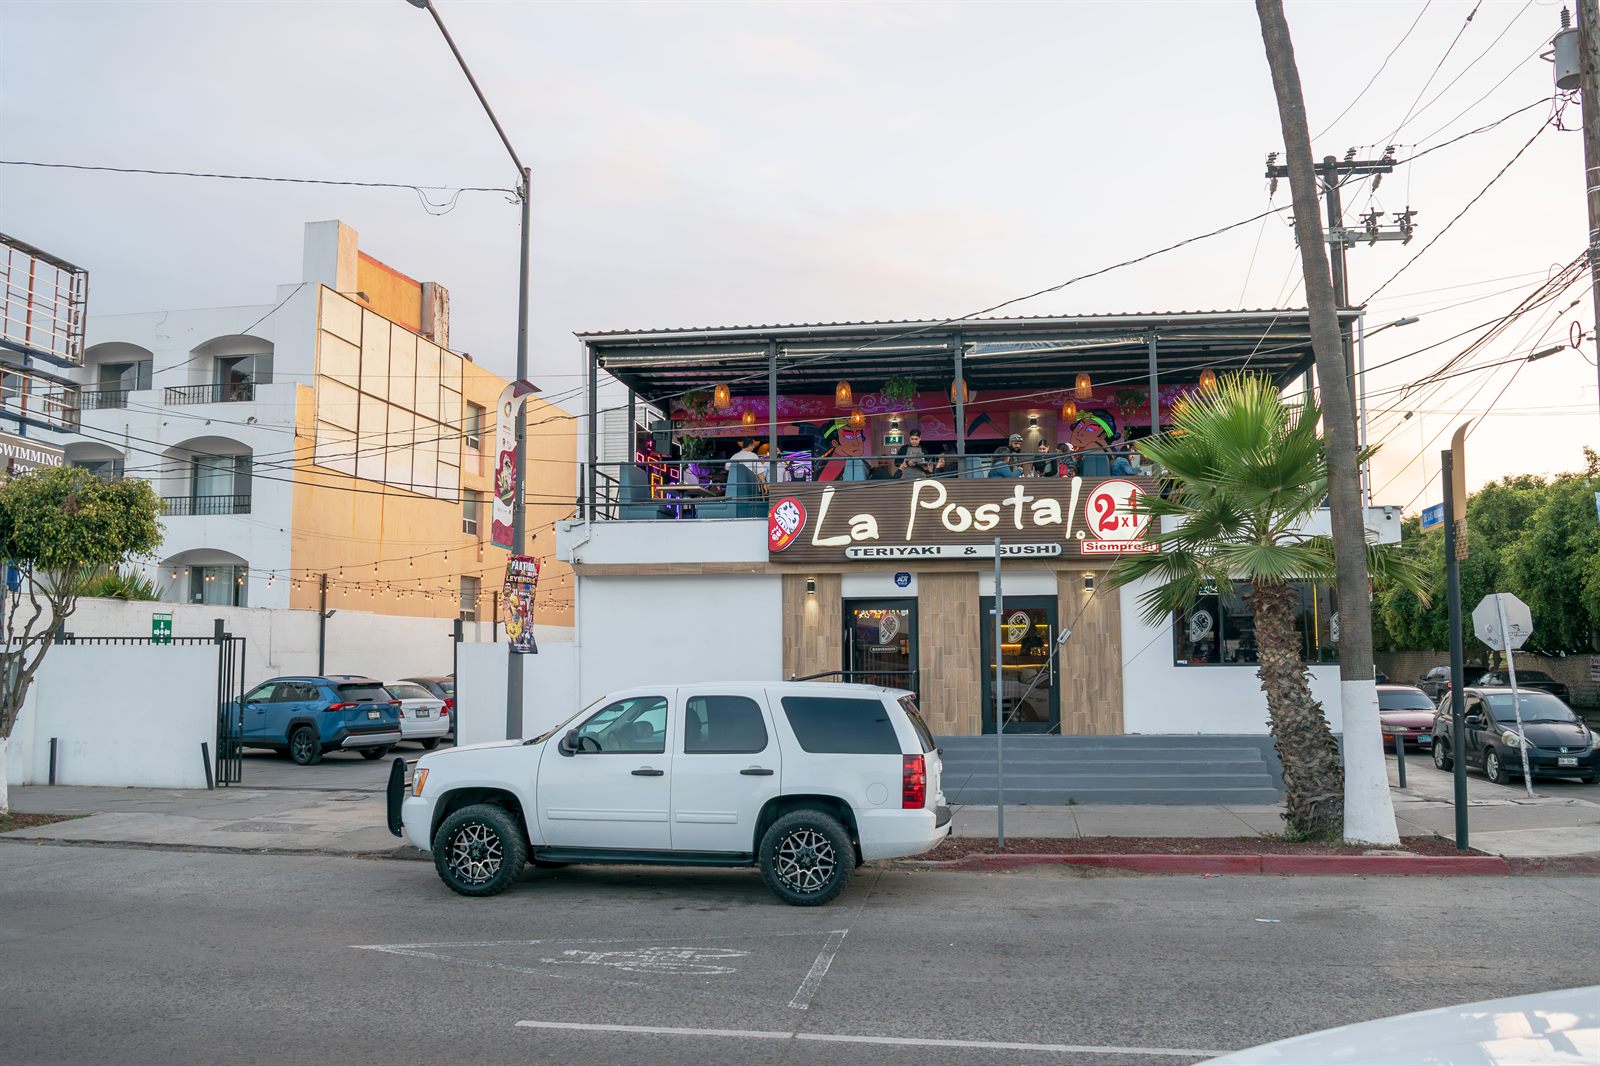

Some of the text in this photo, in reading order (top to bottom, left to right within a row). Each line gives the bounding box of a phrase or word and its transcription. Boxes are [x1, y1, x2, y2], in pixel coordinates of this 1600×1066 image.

[812, 486, 879, 546] La
[850, 547, 941, 557] TERIYAKI
[964, 547, 977, 555] &
